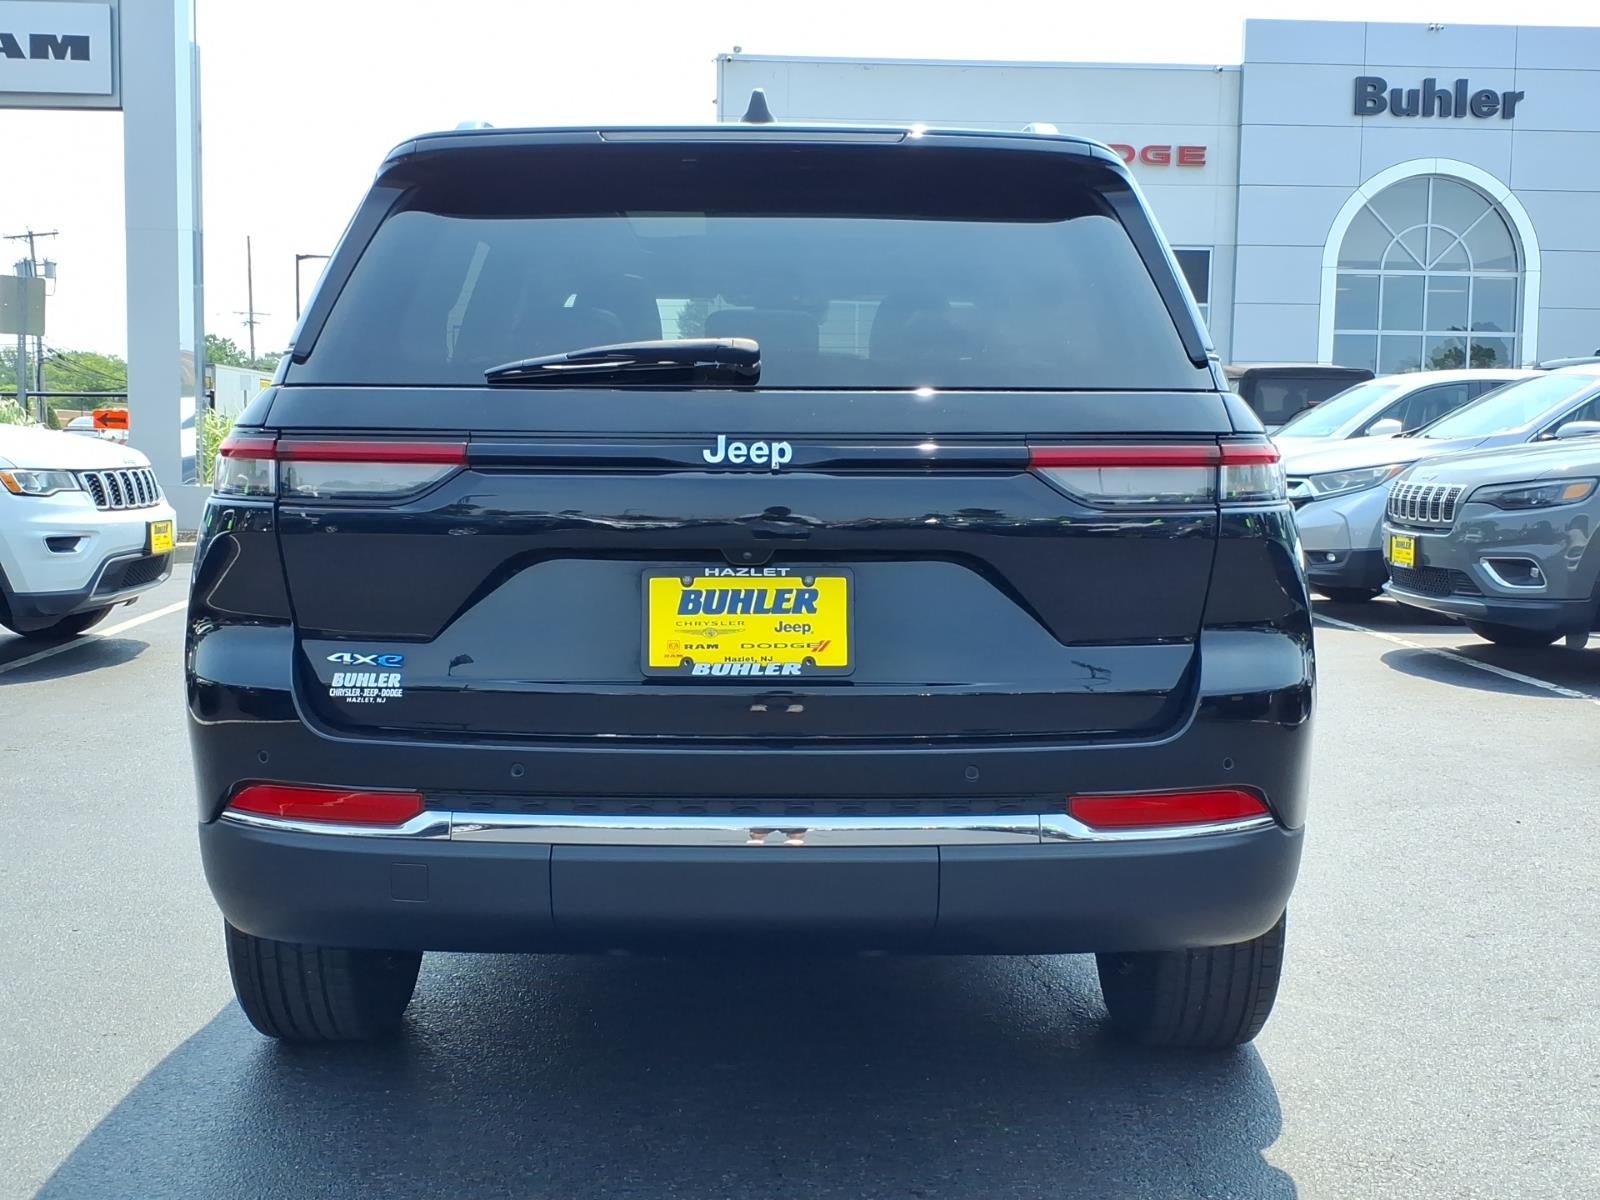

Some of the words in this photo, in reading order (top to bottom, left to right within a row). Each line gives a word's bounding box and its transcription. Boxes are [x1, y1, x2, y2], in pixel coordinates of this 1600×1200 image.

[1354, 76, 1525, 119] Buhler
[702, 434, 793, 470] Jeep
[704, 567, 790, 577] HAZLET
[677, 588, 819, 615] BUHLER
[774, 621, 811, 634] Jeep
[691, 663, 802, 676] BUHLER
[331, 672, 401, 688] BUHLER
